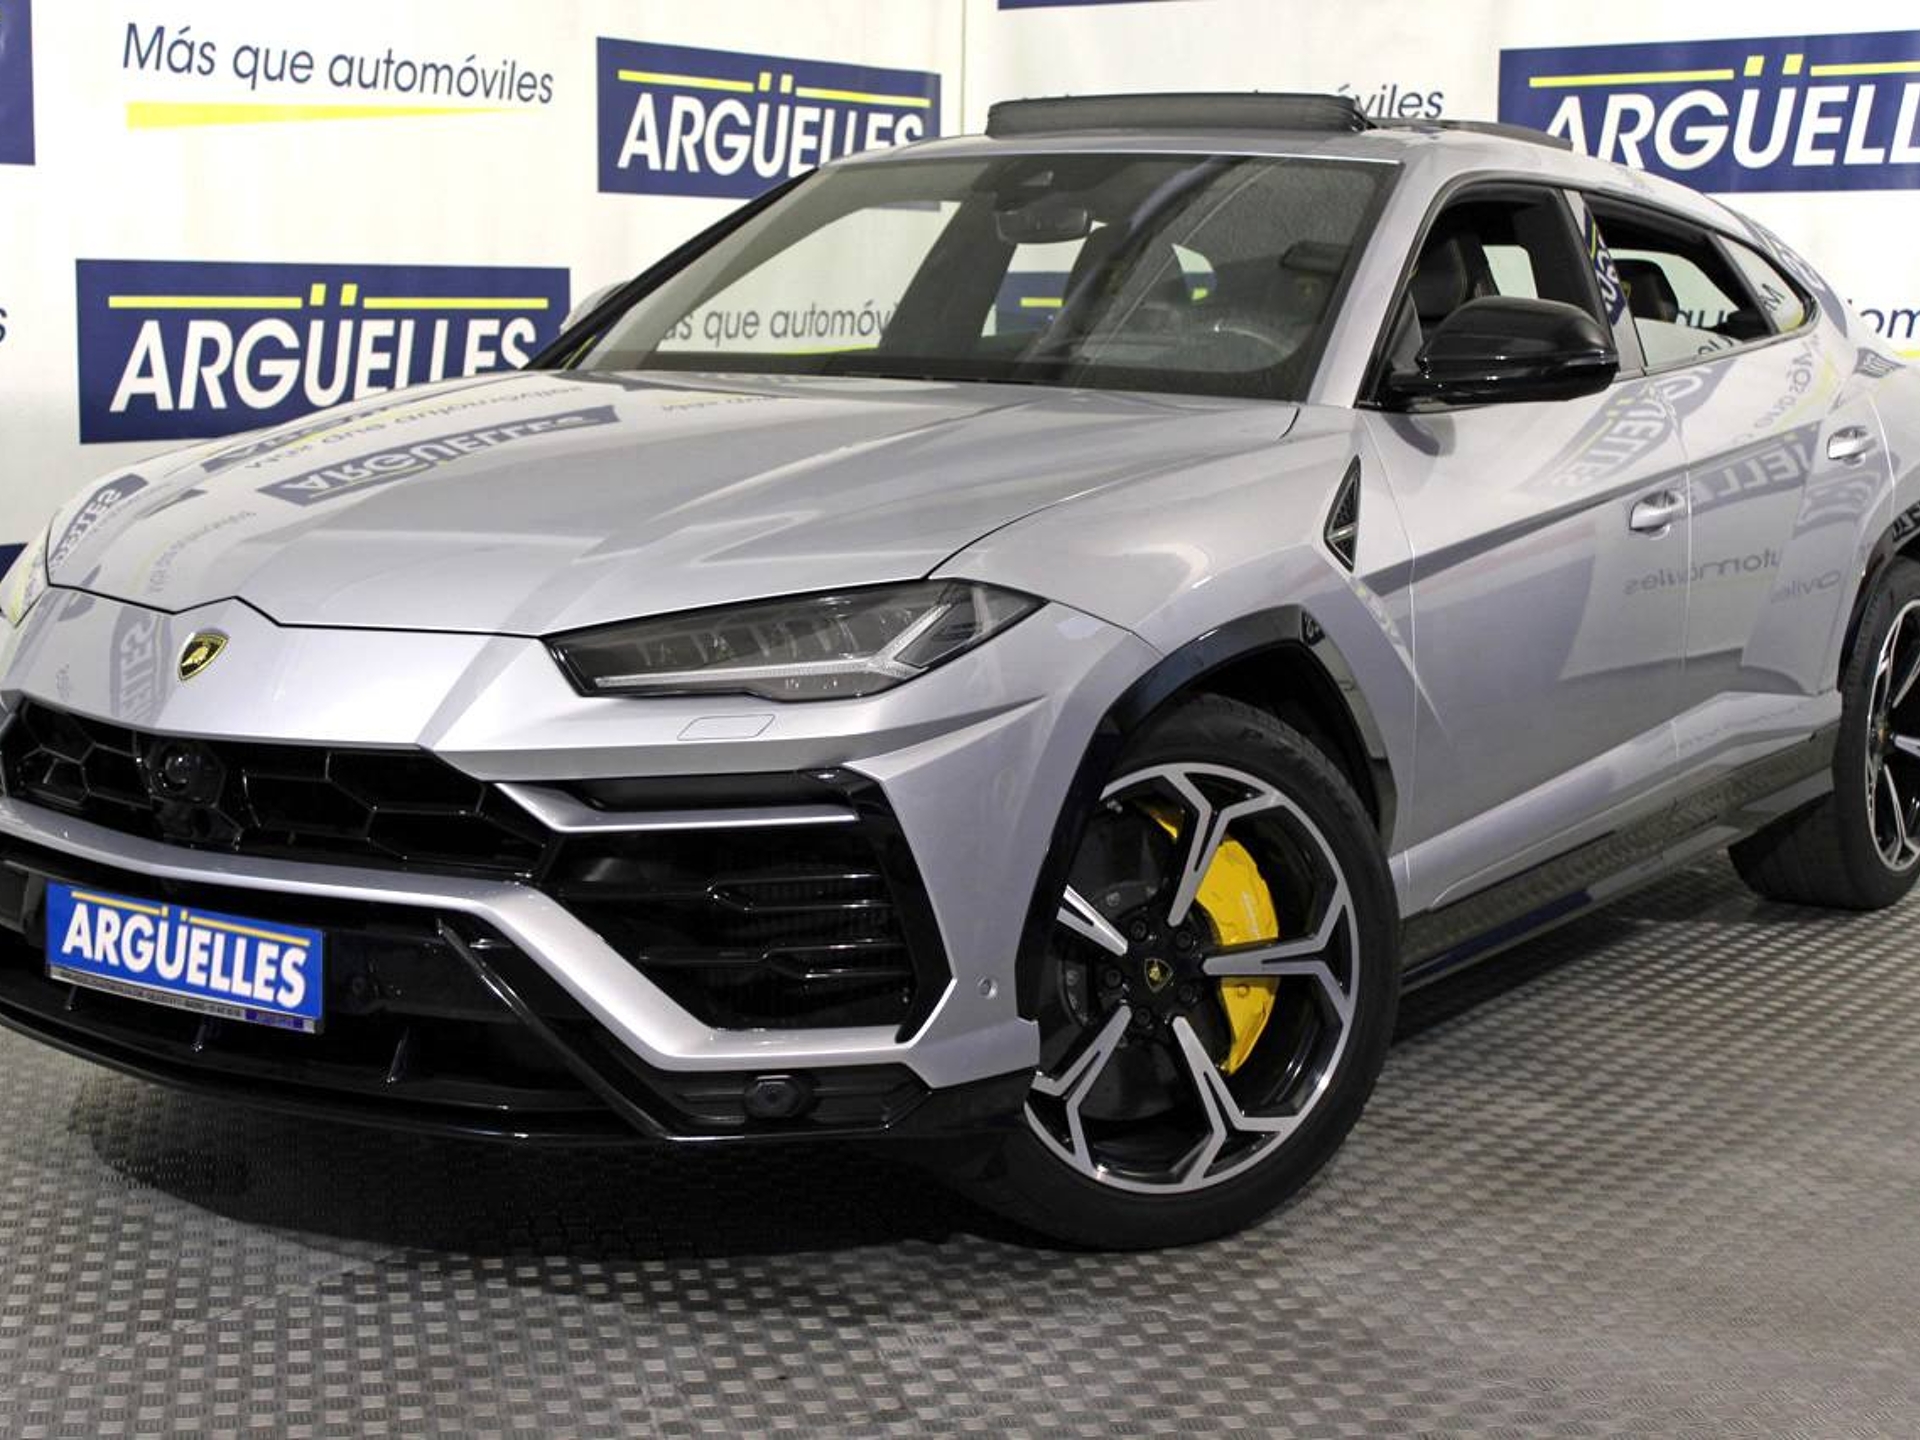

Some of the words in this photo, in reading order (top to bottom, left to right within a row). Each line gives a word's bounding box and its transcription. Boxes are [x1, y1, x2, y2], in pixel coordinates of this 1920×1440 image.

[123, 23, 216, 76] Más
[233, 45, 314, 91] que
[328, 49, 554, 104] automóviles
[109, 282, 538, 413] ARGÜELLES
[703, 310, 761, 348] que
[61, 902, 308, 1009] ARGÜELLES
